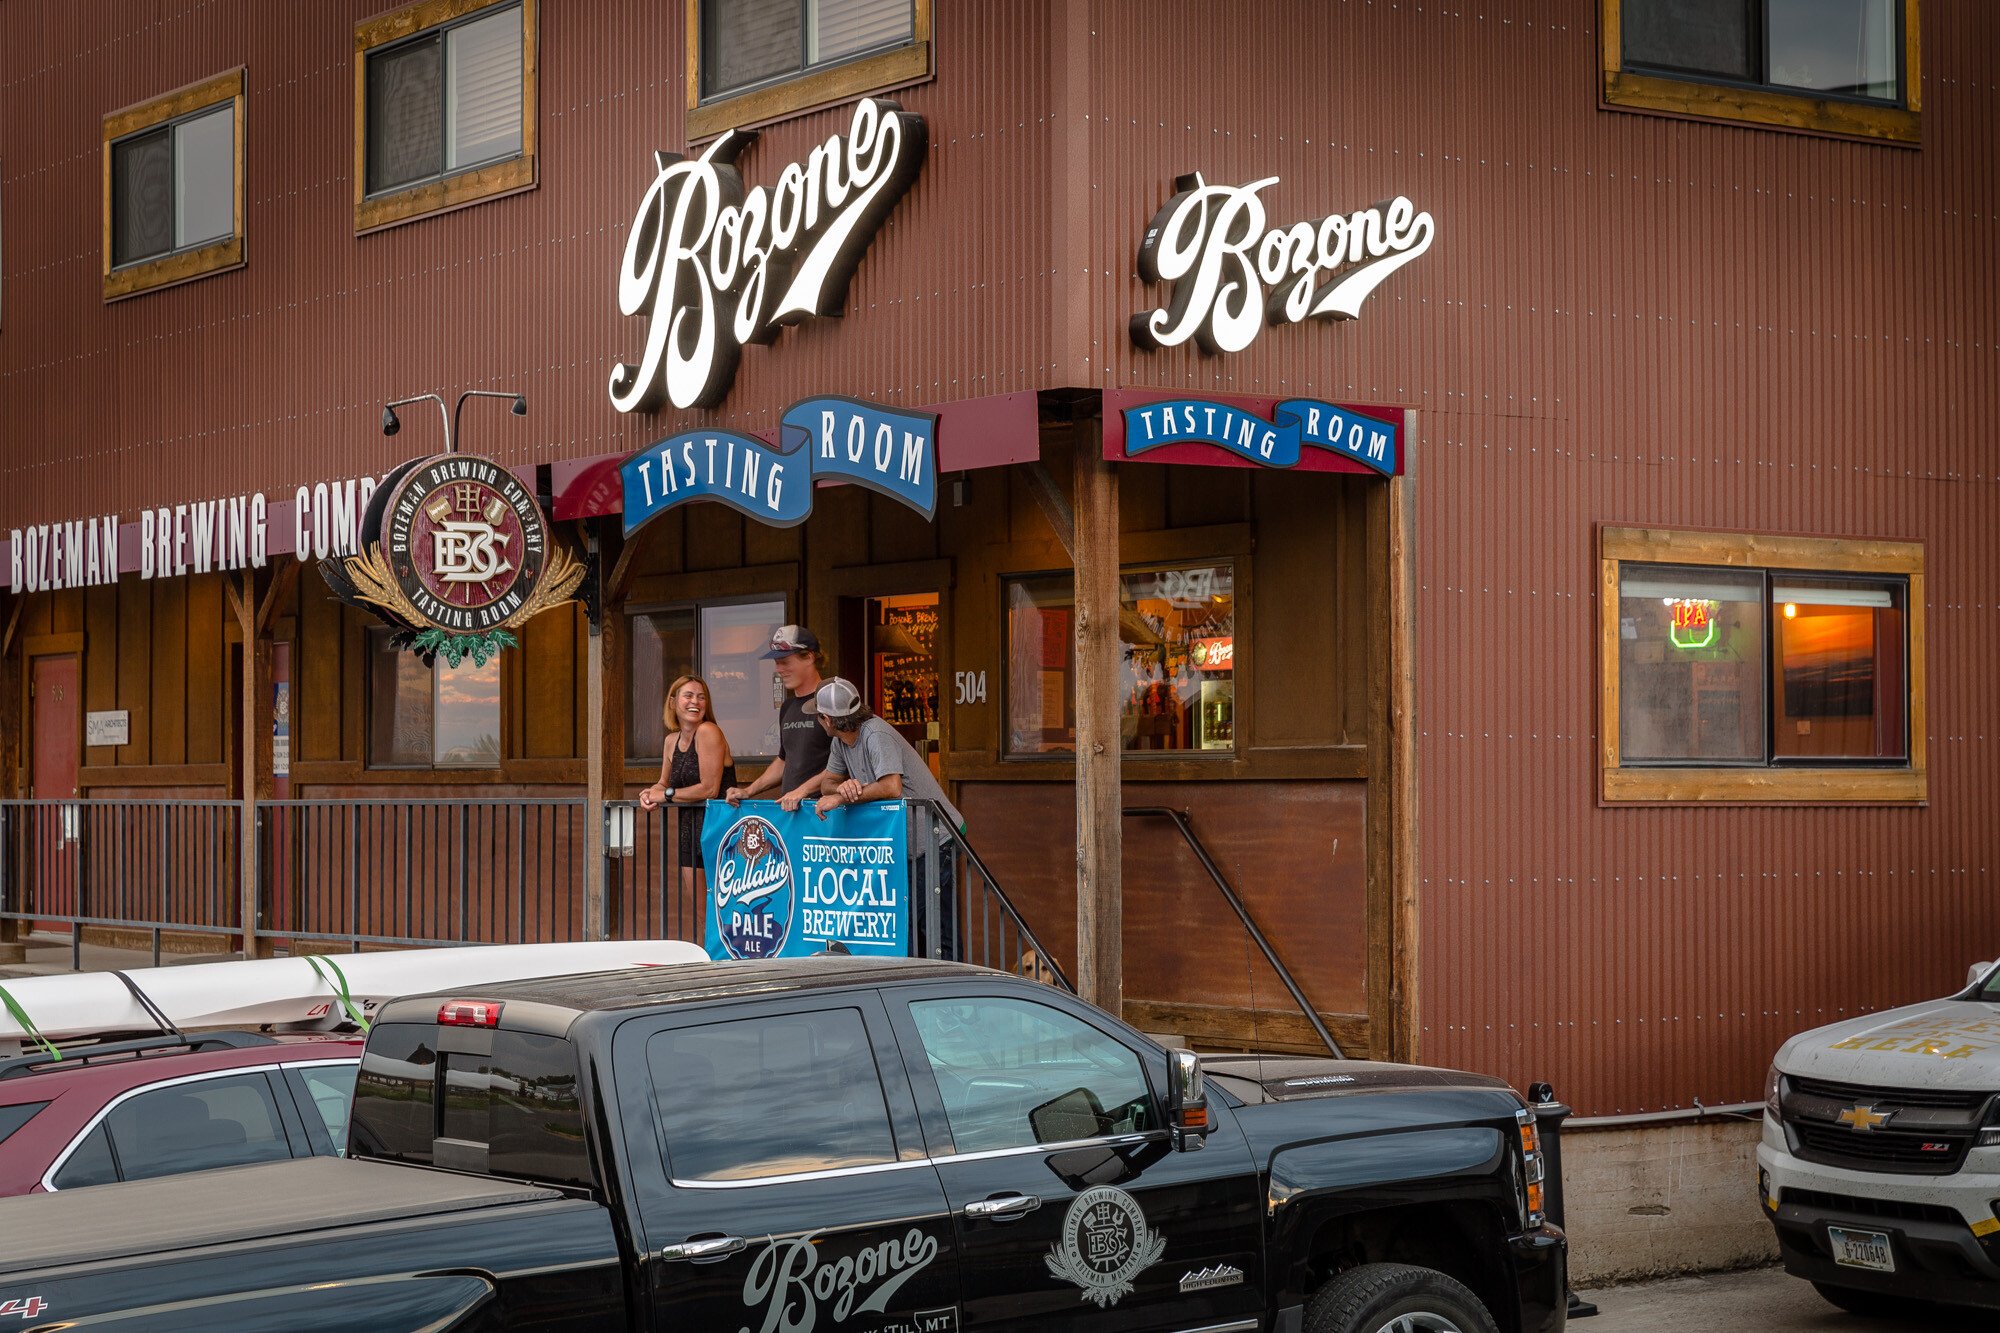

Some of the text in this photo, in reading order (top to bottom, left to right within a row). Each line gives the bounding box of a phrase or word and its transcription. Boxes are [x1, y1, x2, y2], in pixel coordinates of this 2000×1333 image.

[609, 98, 901, 413] Bozone
[1150, 171, 1435, 352] Bozone
[1140, 405, 1388, 462] TASTING ROOM
[638, 438, 785, 512] TASTING
[820, 410, 925, 485] ROOM
[393, 481, 427, 553] BOZEMAN
[430, 461, 498, 485] BREWING
[503, 481, 542, 554] COMPANY
[11, 515, 118, 594] BOZEMAN
[141, 492, 267, 580] BREWING
[412, 586, 522, 628] TASTING ROOM
[1674, 603, 1706, 627] IPA
[955, 670, 987, 704] 504
[783, 720, 815, 730] DAKINE
[803, 844, 895, 864] SUPPORT YOUR
[717, 854, 789, 907] Gallatin
[803, 867, 896, 906] LOCAL
[732, 911, 774, 939] PALE
[803, 909, 896, 939] BREWERY!
[744, 941, 761, 953] ALE
[1068, 1191, 1143, 1247] BOZEMAN BREWING COMPANY
[738, 1227, 938, 1333] Bozone
[1075, 1250, 1140, 1284] BOZEMAN MONTANA
[926, 1315, 950, 1332] MT
